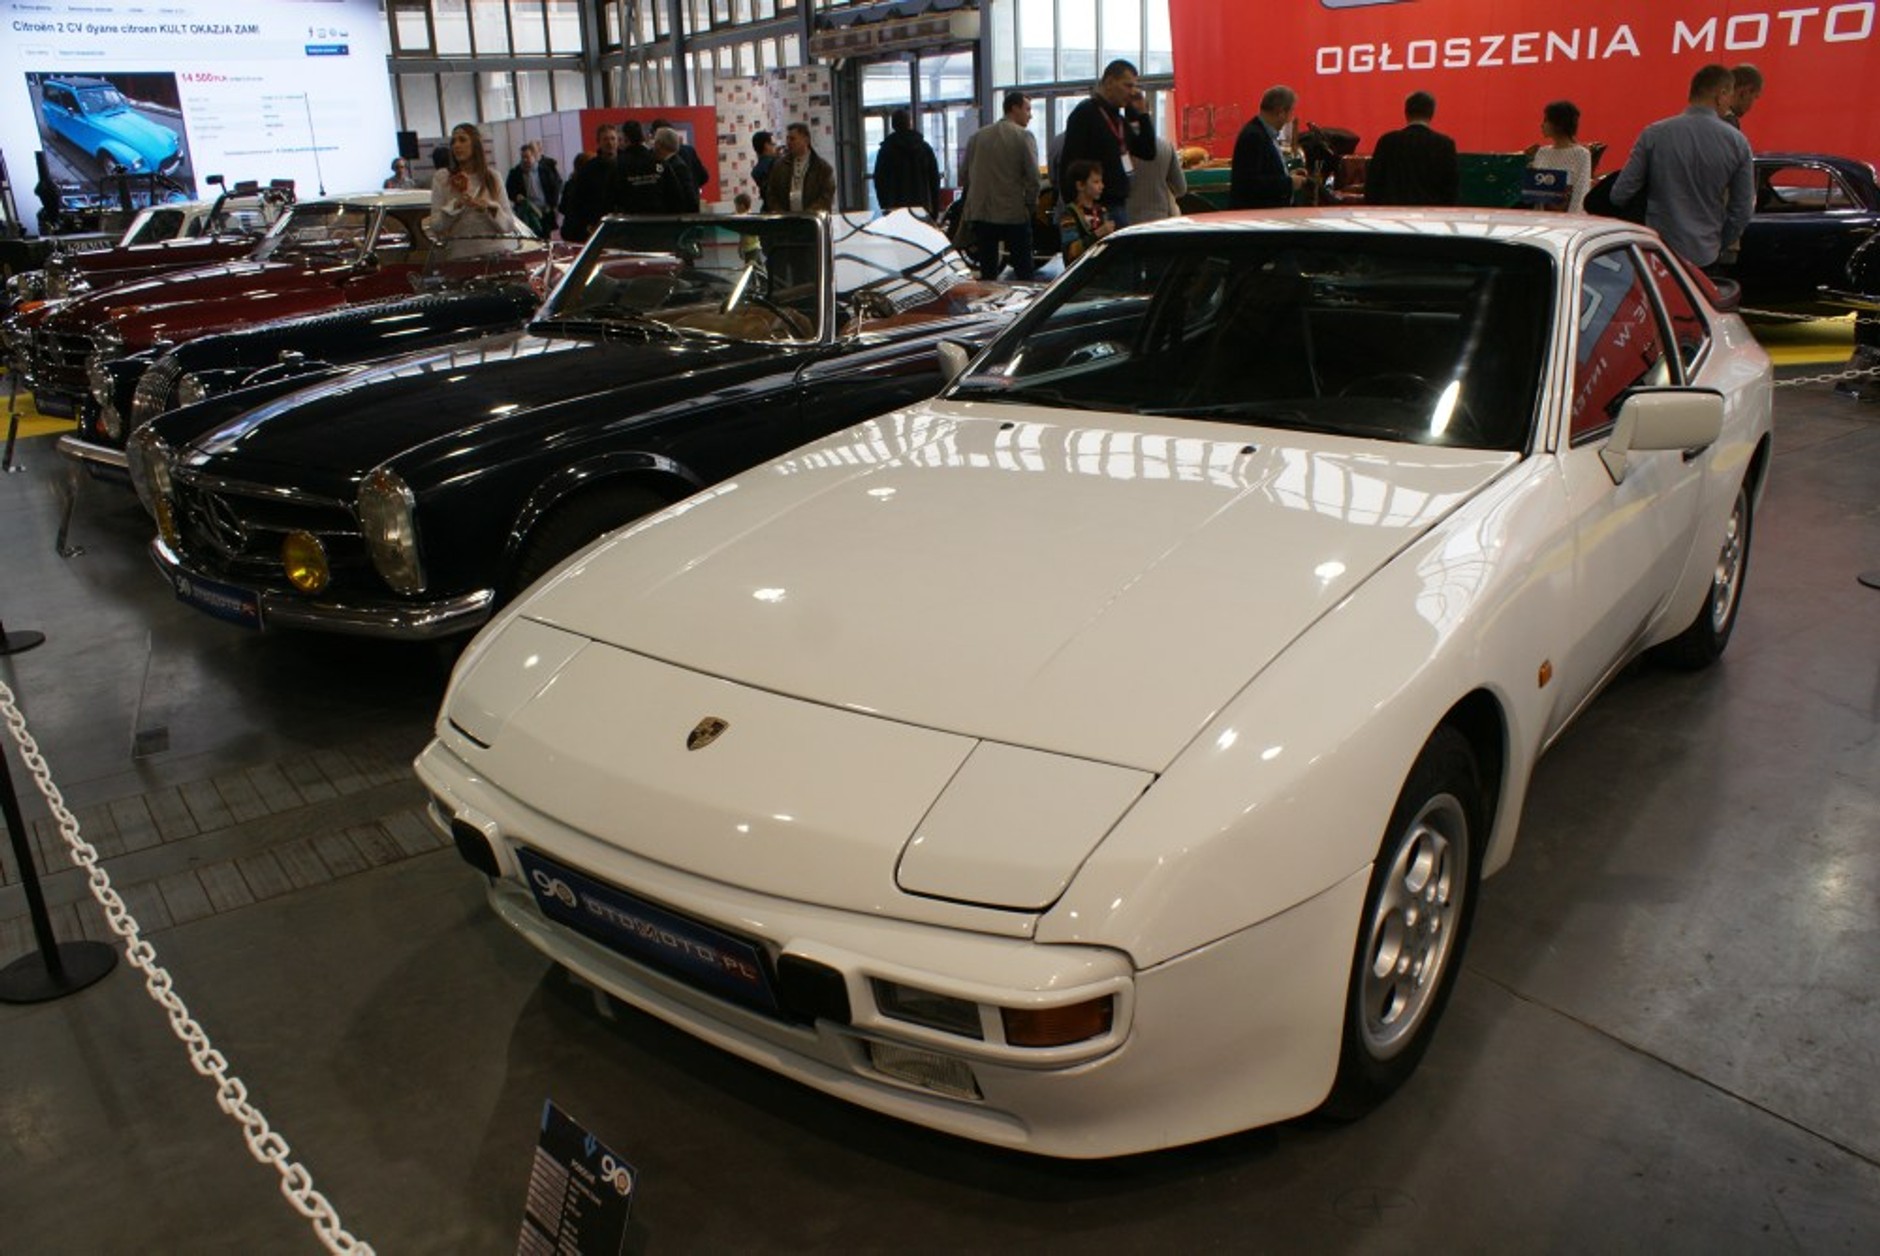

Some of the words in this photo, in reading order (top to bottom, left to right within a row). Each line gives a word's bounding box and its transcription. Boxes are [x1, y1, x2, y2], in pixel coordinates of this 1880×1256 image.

[57, 23, 64, 33] 2
[66, 23, 82, 33] CV
[160, 24, 187, 35] KULT
[190, 24, 232, 35] OKAZJA
[1316, 23, 1640, 75] OGŁOSZENIA
[1672, 1, 1875, 53] MOTO
[601, 1154, 631, 1196] 90
